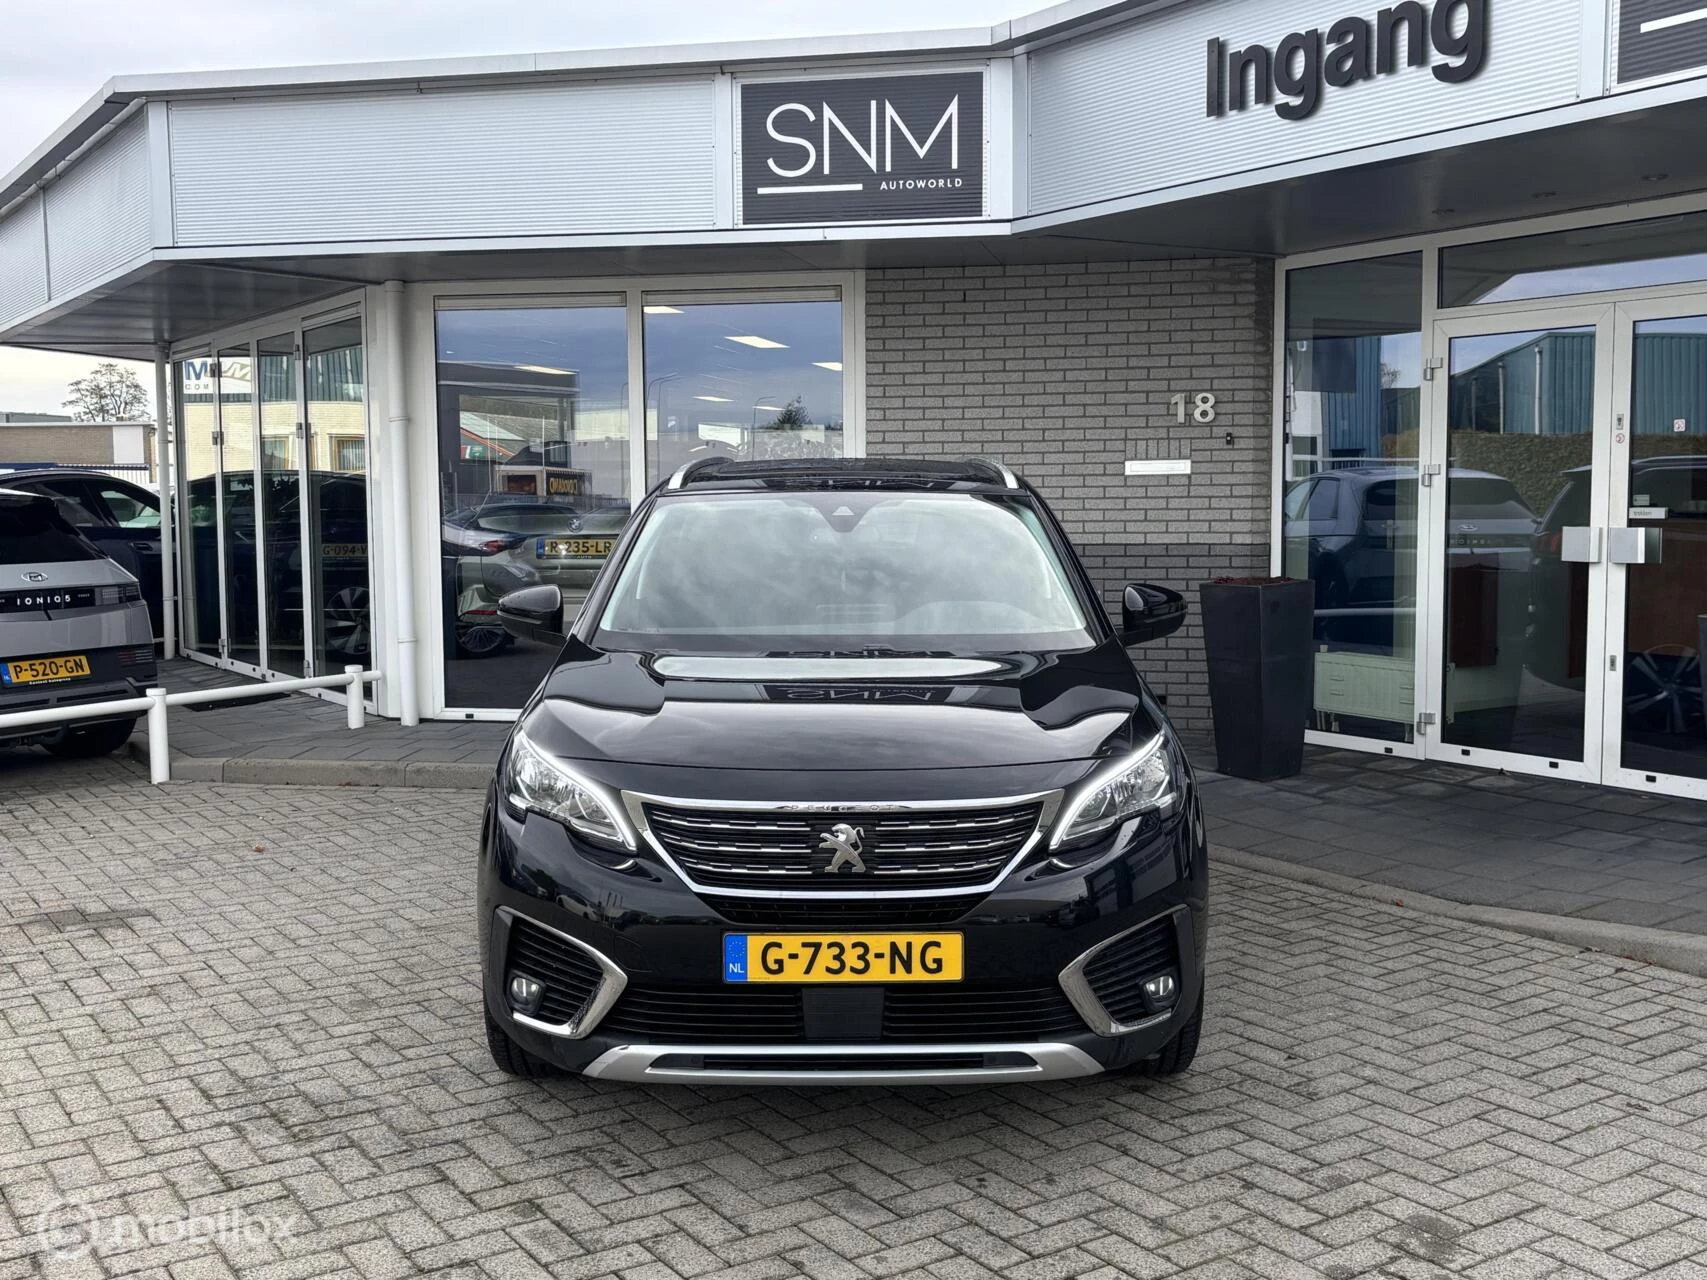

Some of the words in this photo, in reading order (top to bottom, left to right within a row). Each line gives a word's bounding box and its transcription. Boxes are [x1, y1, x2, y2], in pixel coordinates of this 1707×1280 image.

[1206, 0, 1488, 120] Ingang
[766, 94, 959, 177] SNM
[880, 178, 963, 190] AUTOWORLD
[1170, 392, 1216, 424] 18
[550, 541, 612, 553] R235-LR
[13, 658, 85, 680] P-520-GN
[729, 963, 744, 973] NL
[761, 941, 943, 974] G-733-NG
